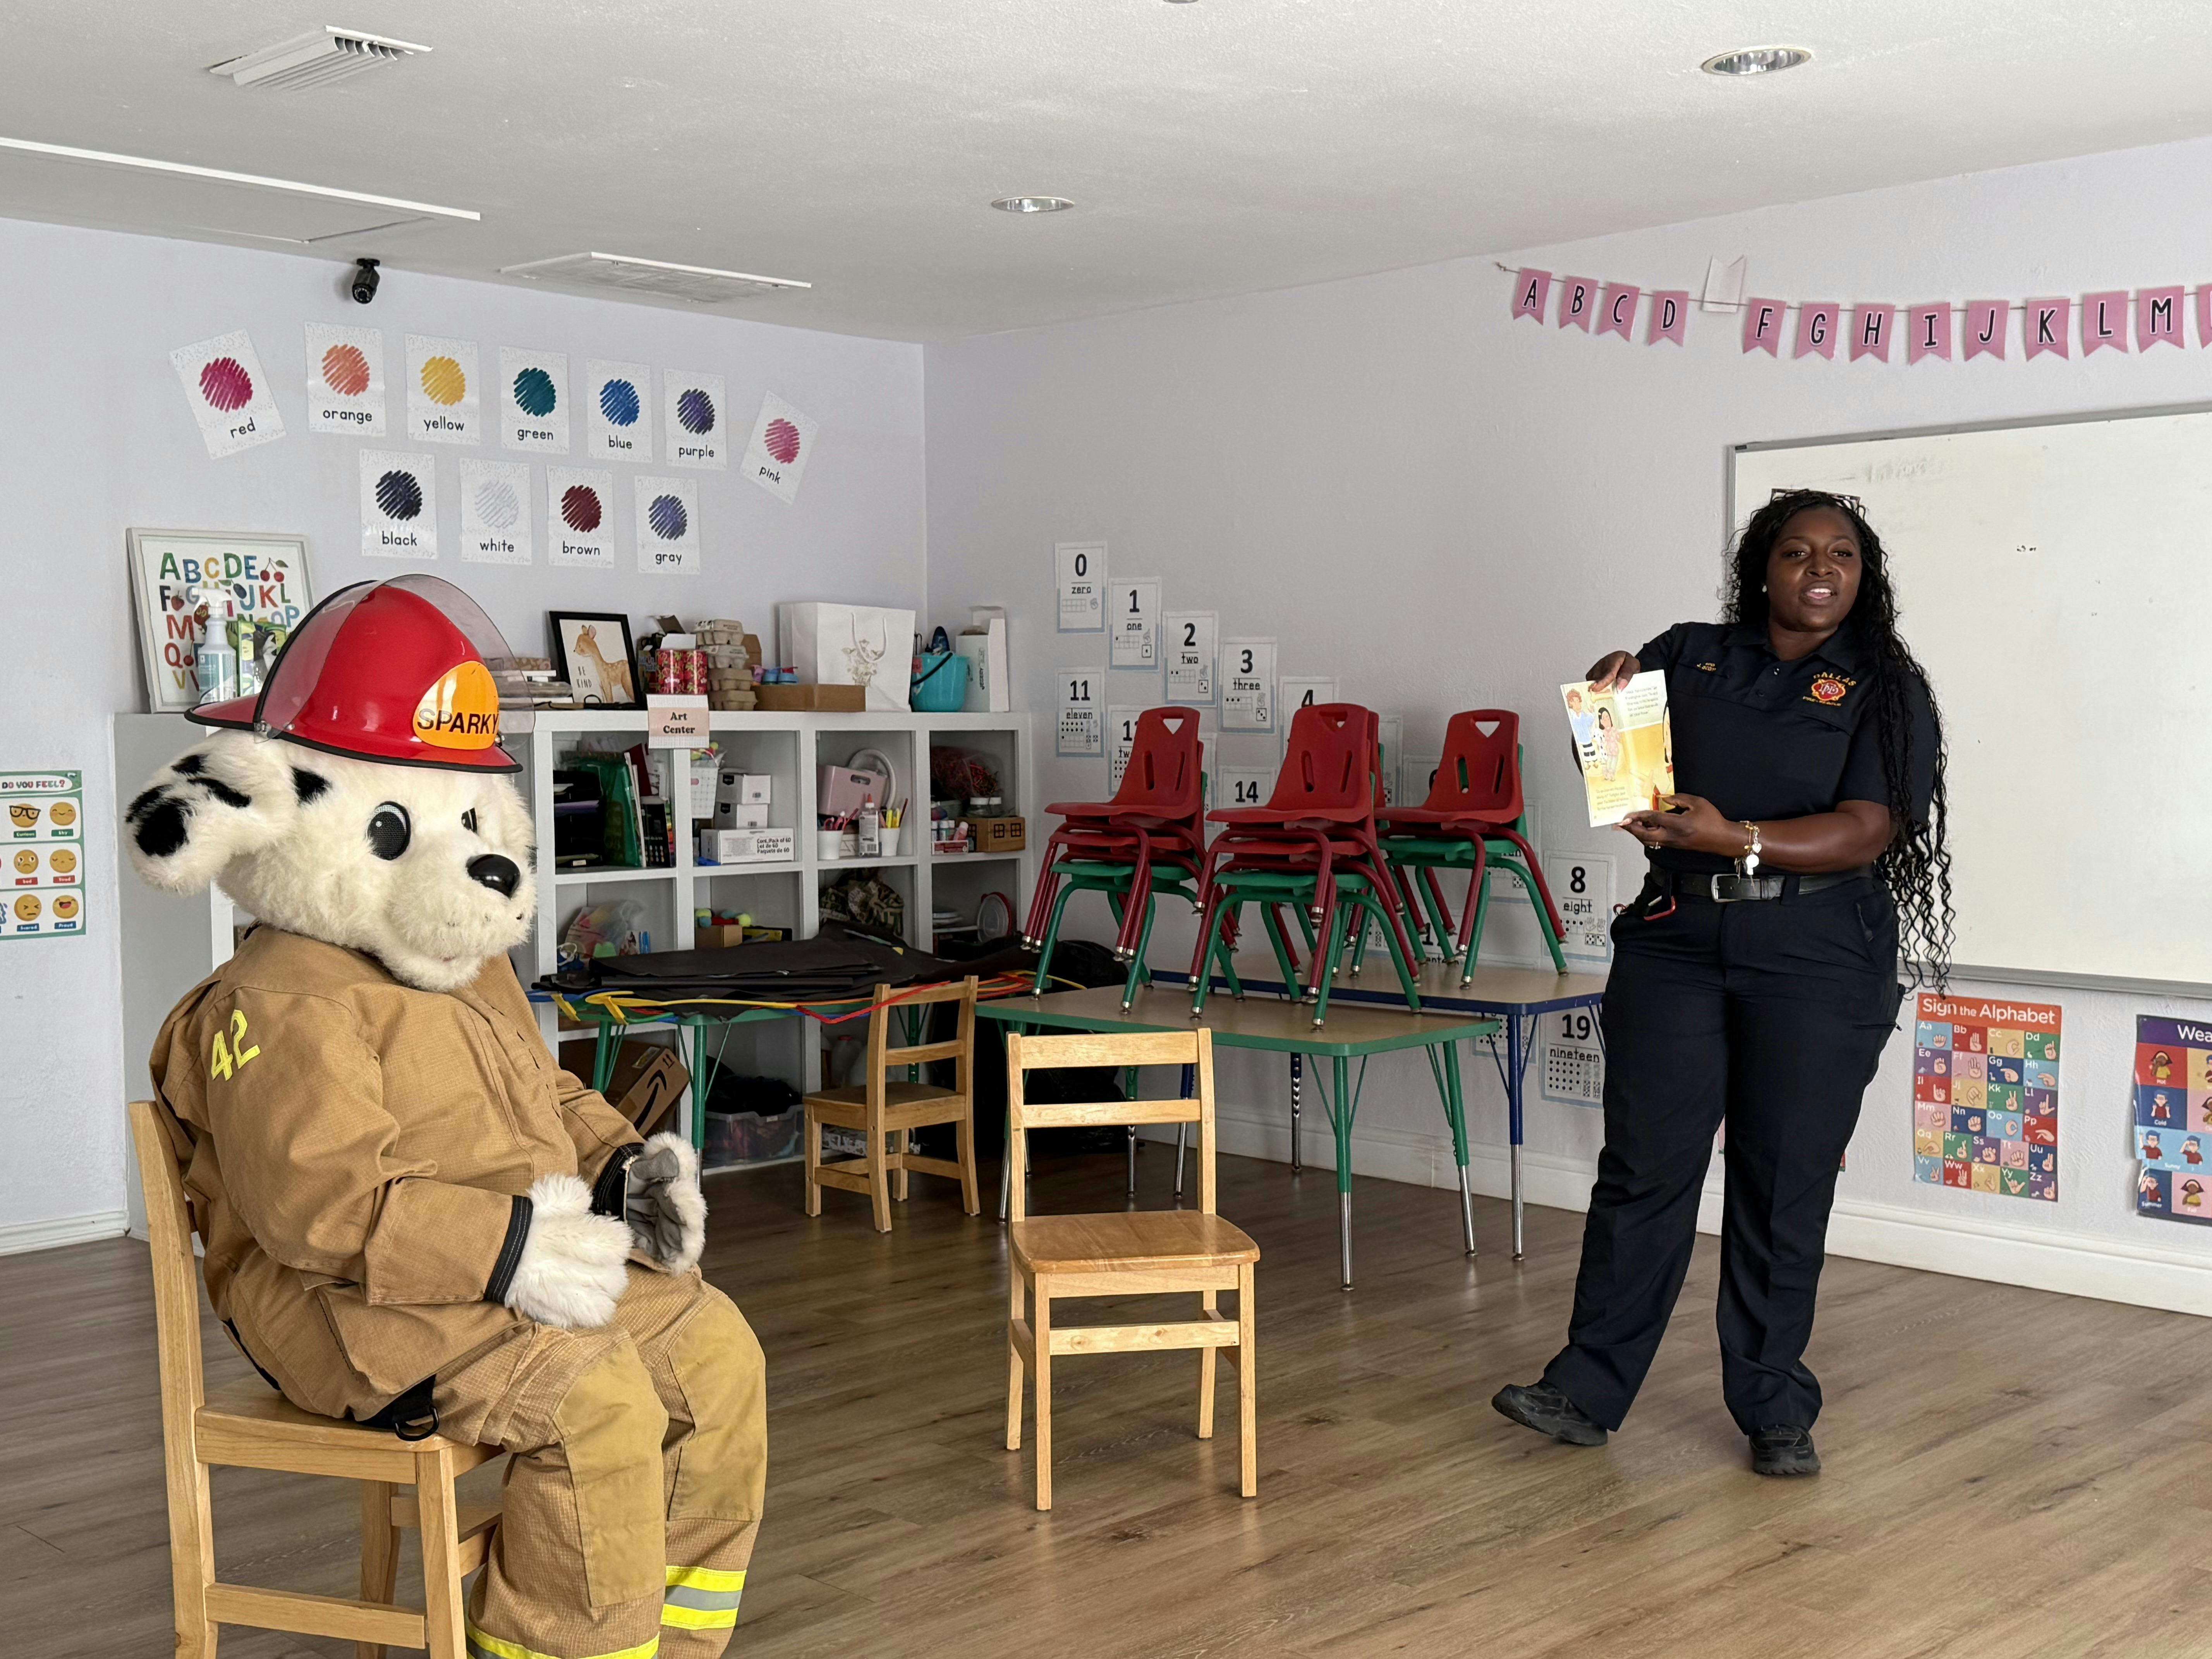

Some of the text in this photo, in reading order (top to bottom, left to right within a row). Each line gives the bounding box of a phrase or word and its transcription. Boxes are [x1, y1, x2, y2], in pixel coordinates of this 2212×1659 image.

[1524, 279, 2172, 346] A B C D F G H I J K L M
[323, 409, 373, 424] orange
[230, 418, 256, 439] red
[424, 417, 465, 432] yellow
[517, 428, 553, 441] green
[608, 436, 632, 450] blue
[678, 446, 714, 459] purple
[759, 467, 781, 484] pink
[382, 532, 417, 547] black
[480, 541, 514, 553] white
[563, 542, 601, 556] brown
[655, 552, 682, 565] gray
[1075, 553, 1087, 577] 0
[160, 553, 259, 583] ABCDE
[1072, 586, 1091, 594] zero
[1129, 589, 1140, 613] 1
[1127, 622, 1142, 631] one
[1184, 623, 1196, 646] 2
[1181, 653, 1199, 664] two
[1240, 649, 1253, 673] 3
[578, 666, 586, 675] BE
[577, 678, 592, 688] KIND
[1233, 678, 1261, 690] three
[1814, 672, 1856, 686] DALLAS
[1070, 680, 1091, 701] 11
[417, 708, 499, 734] SPARKY
[670, 712, 687, 721] Art
[1066, 708, 1093, 719] eleven
[663, 725, 695, 734] Center
[36, 780, 65, 788] FEEL?
[1235, 781, 1259, 803] 14
[1570, 866, 1586, 893] 8
[1563, 900, 1593, 914] eight
[1922, 998, 2055, 1024] Sign the Alphabet
[1562, 1014, 1590, 1040] 19
[1919, 1022, 2040, 1041] Aa Bb Cc Dd
[2177, 1024, 2212, 1042] Wea
[211, 1009, 260, 1081] 42
[1550, 1047, 1599, 1063] nineteen
[1919, 1048, 1931, 1057] Ee
[1989, 1056, 2002, 1067] Gg
[2025, 1060, 2038, 1069] Hh
[1989, 1084, 2001, 1092] Kk
[1918, 1103, 2037, 1126] Mm Nn Oo Pp
[1917, 1129, 1931, 1139] Qq
[1973, 1137, 1984, 1145] Ss
[2030, 1144, 2043, 1154] Uu
[1918, 1156, 1929, 1164] Vv
[1945, 1161, 1963, 1169] Ww
[2002, 1168, 2013, 1178] Yy
[2030, 1173, 2042, 1181] Zz
